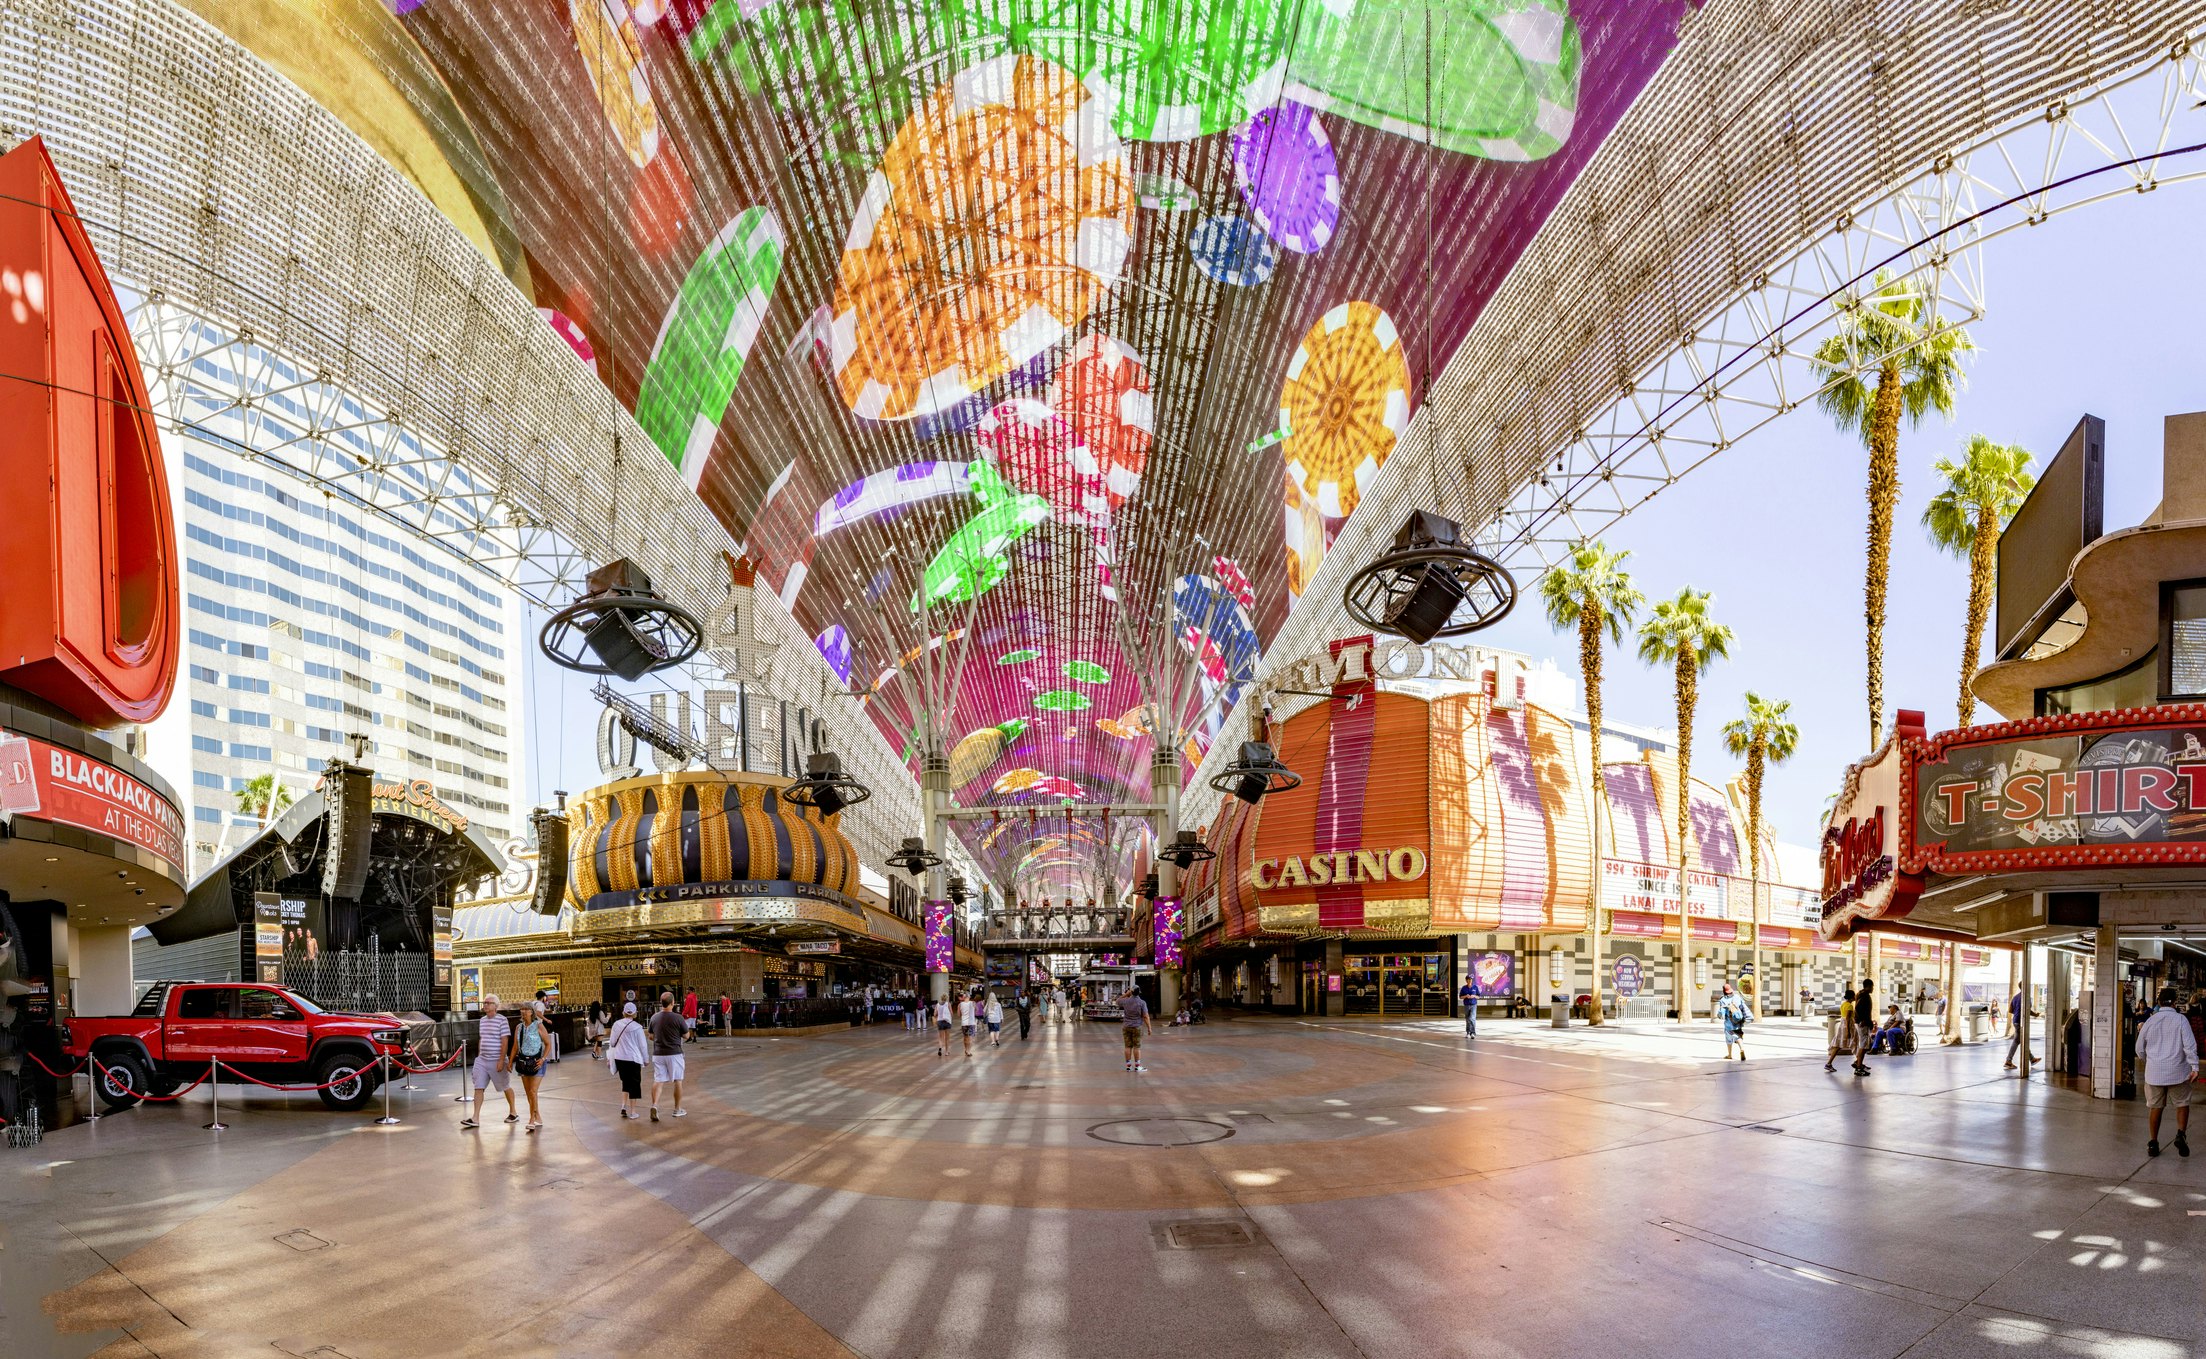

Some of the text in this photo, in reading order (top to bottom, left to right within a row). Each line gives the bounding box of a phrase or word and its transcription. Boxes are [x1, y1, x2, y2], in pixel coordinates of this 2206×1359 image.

[2082, 748, 2105, 765] ELVIS
[50, 749, 152, 816] BLACKJACK
[154, 797, 176, 834] PAYS
[372, 799, 450, 832] PERIENCE
[404, 779, 469, 831] Street
[104, 807, 121, 832] AT
[124, 813, 143, 841] THE
[1250, 846, 1428, 891] CASINO
[1605, 862, 1720, 887] 99¢ SHRIMP CCKTAIL
[678, 883, 769, 898] PARKING
[1637, 879, 1692, 896] SINCE 196
[281, 900, 306, 913] RSHIP
[1623, 895, 1705, 914] LANAI EXPESS
[605, 962, 678, 972] 4 QUEENS
